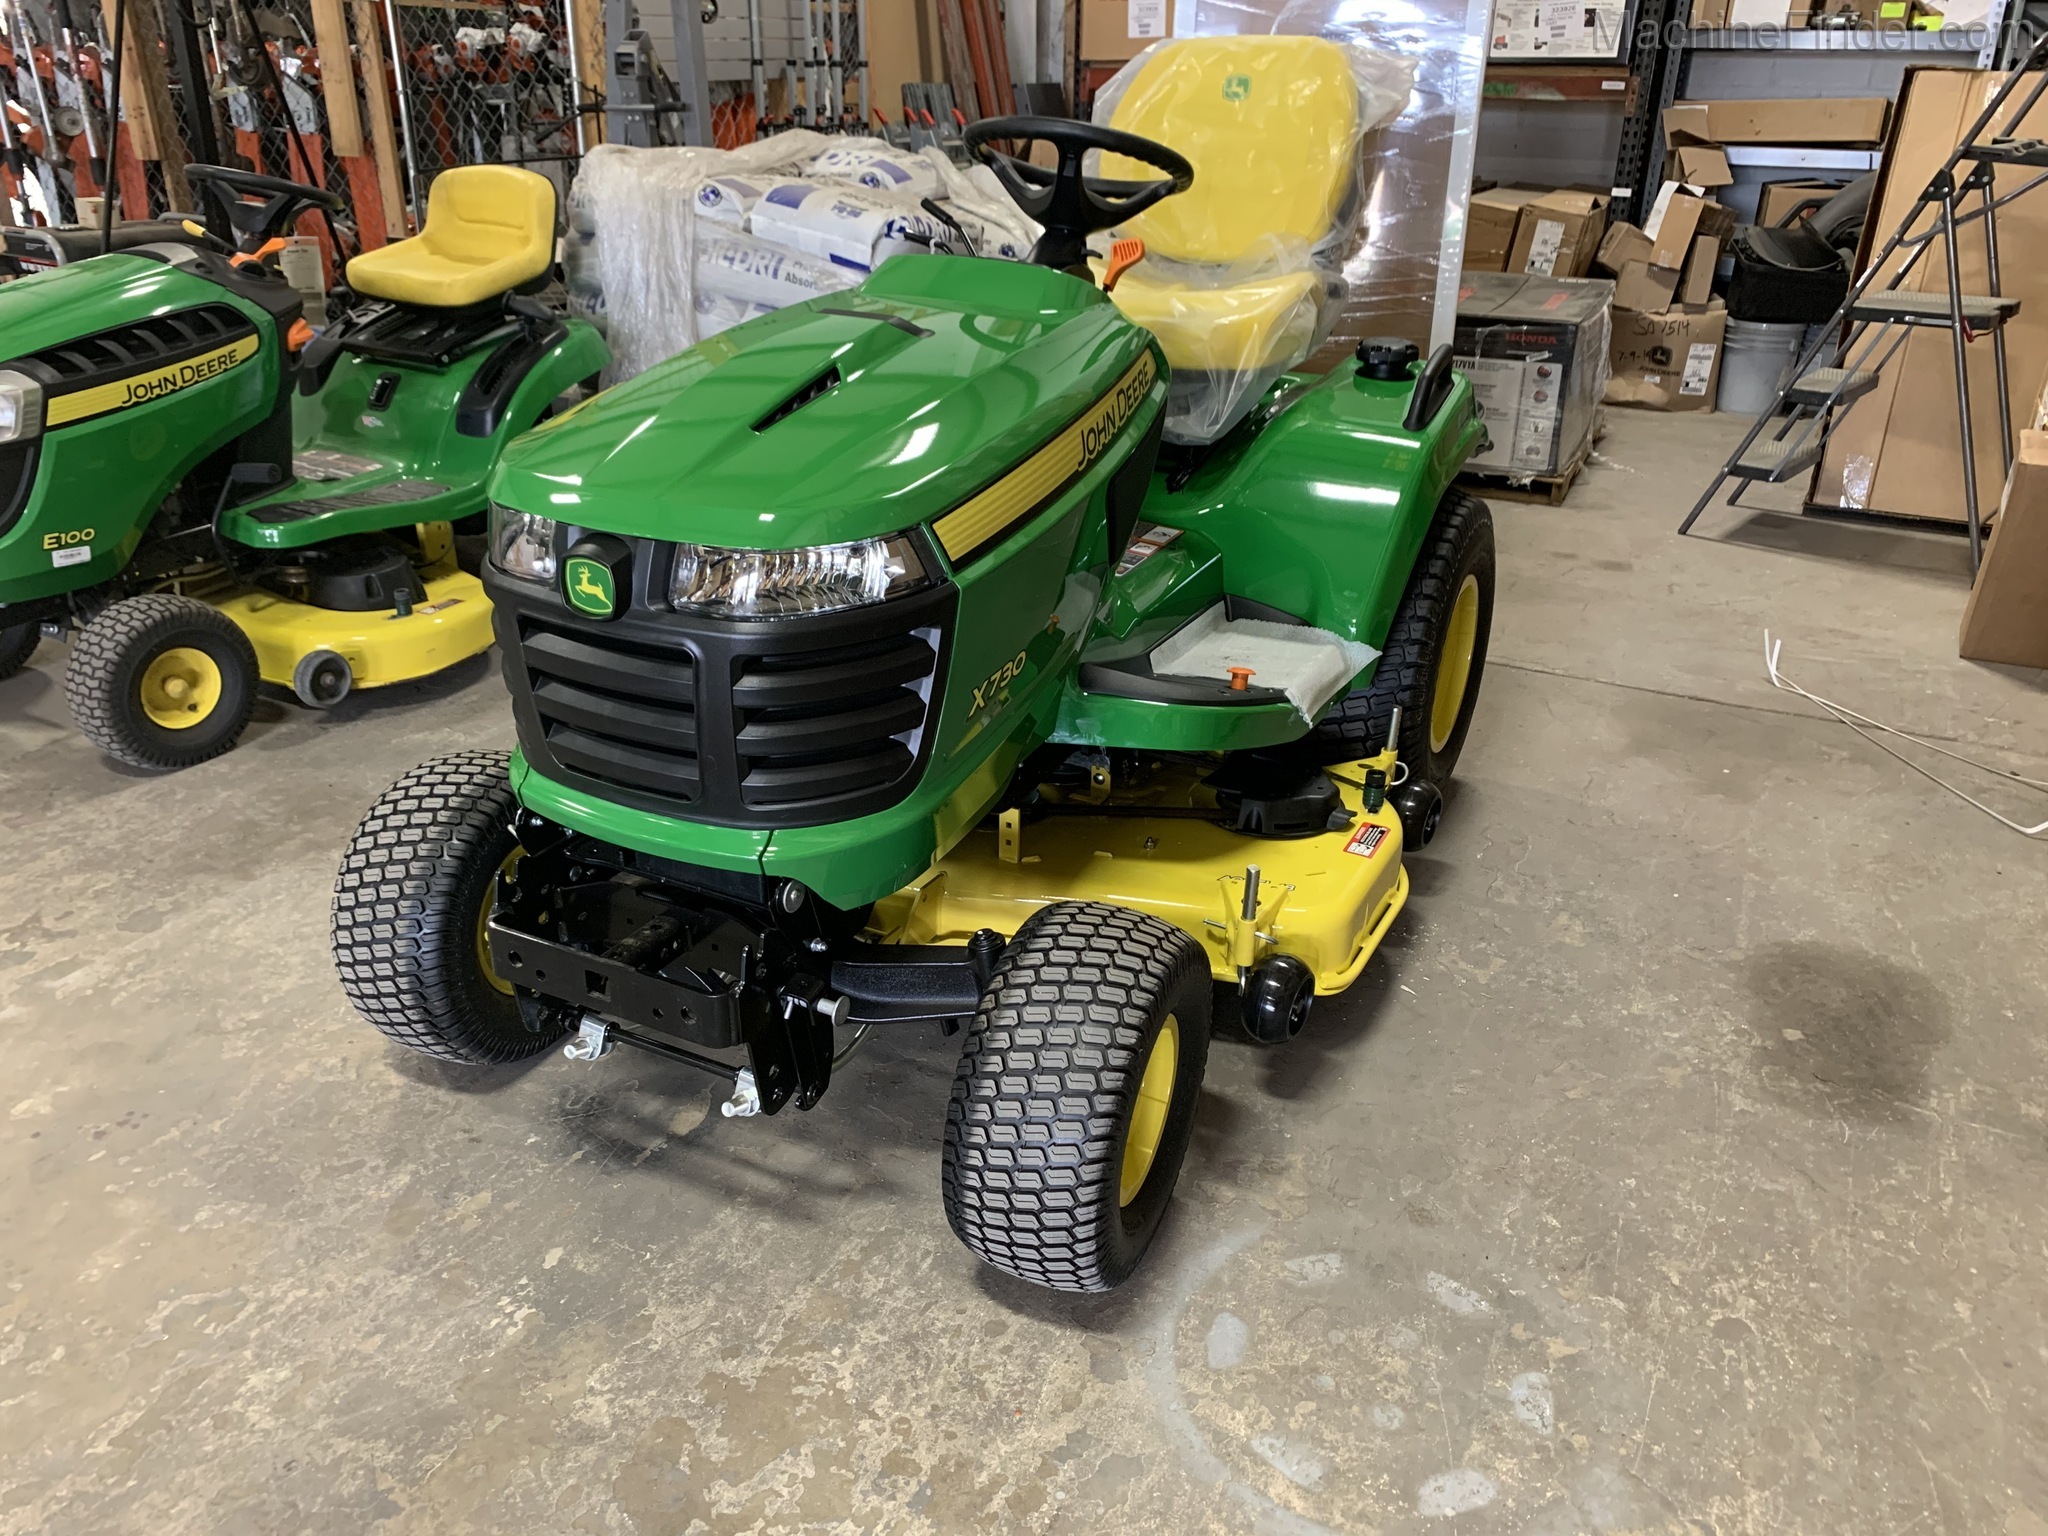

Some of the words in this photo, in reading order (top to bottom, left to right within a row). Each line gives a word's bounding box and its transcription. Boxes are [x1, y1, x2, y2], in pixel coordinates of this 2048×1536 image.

[1505, 333, 1557, 345] HONDA
[121, 373, 178, 405] JOHN
[179, 349, 239, 384] DEERE
[1078, 404, 1117, 469] JOHN
[1116, 360, 1150, 420] DEERE
[43, 527, 95, 550] E100
[967, 650, 1027, 719] X730
